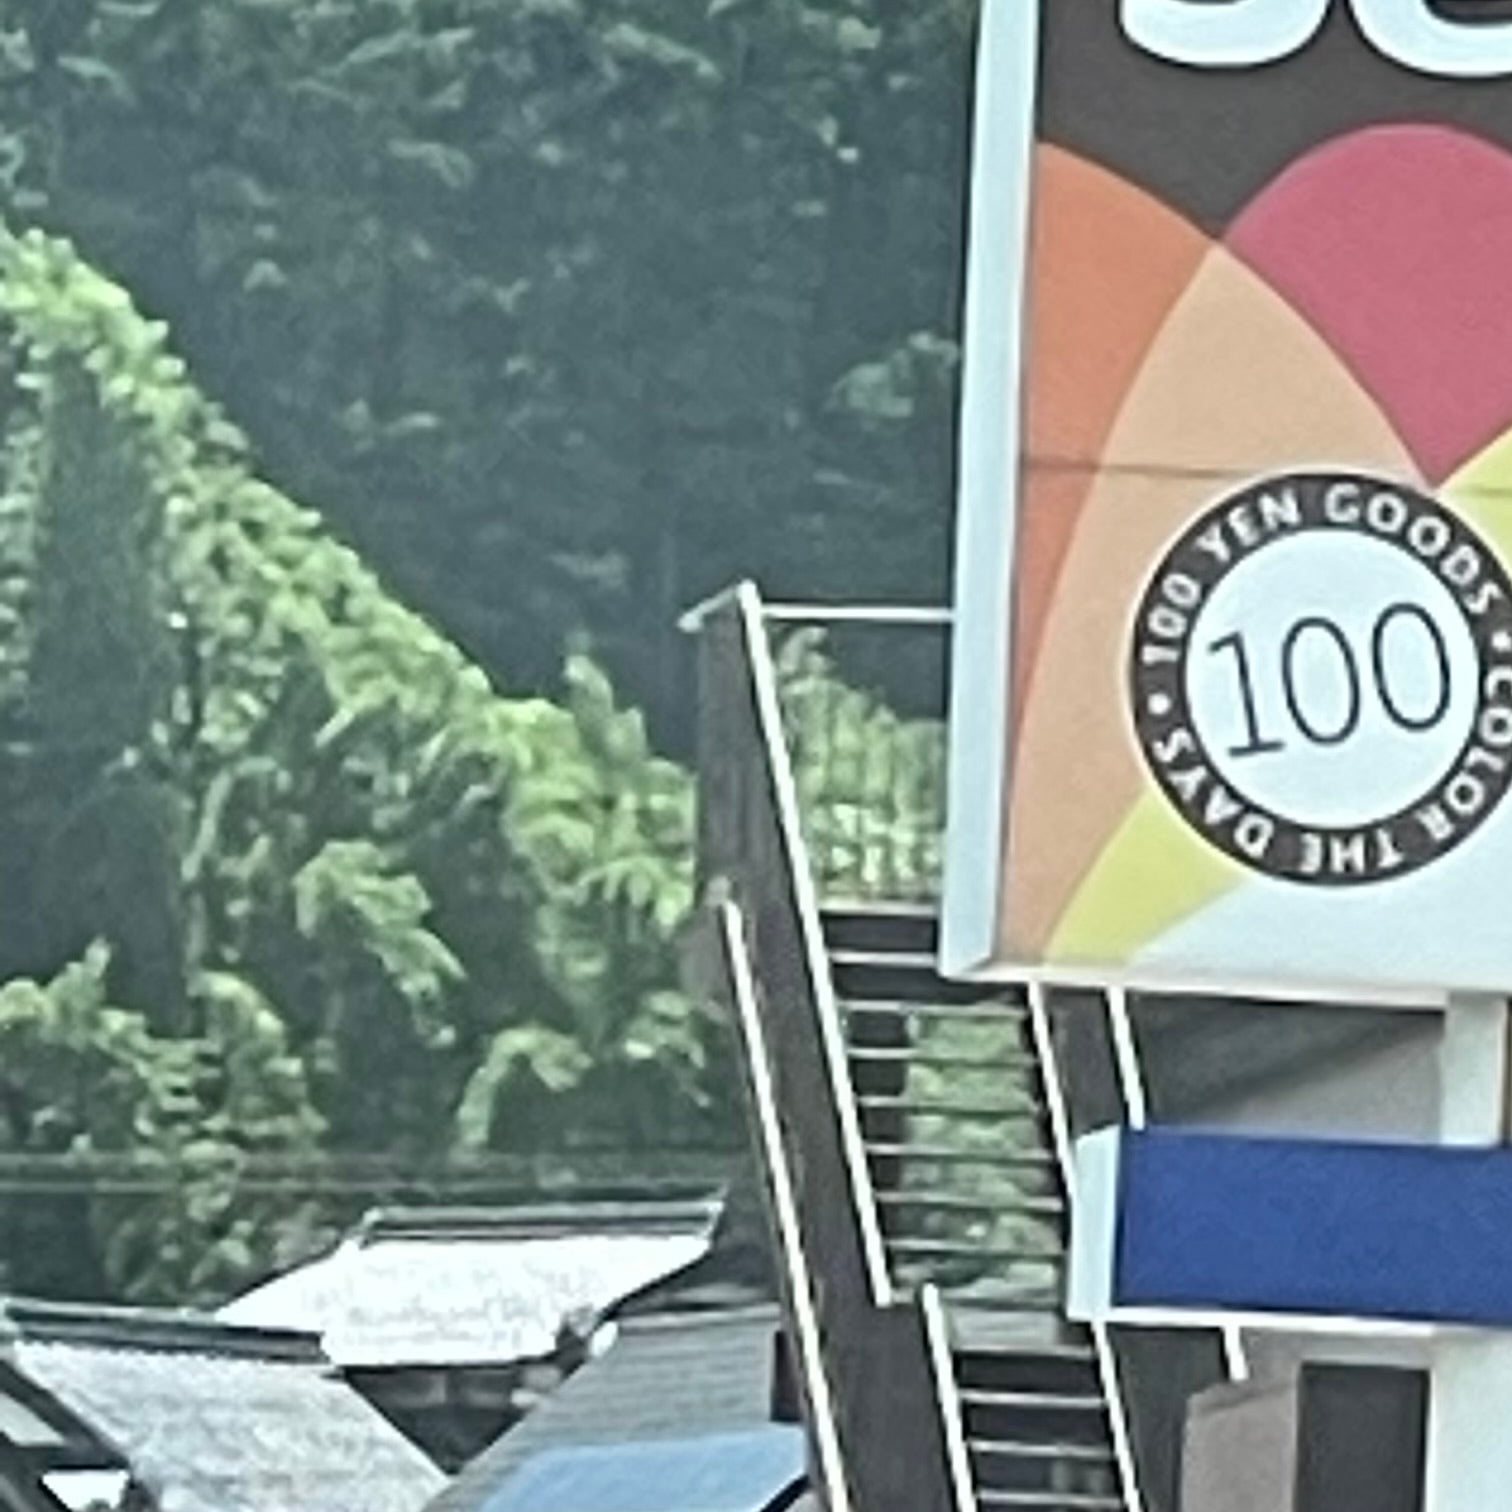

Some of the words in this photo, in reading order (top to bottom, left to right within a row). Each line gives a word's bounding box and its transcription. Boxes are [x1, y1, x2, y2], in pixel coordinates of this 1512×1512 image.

[1142, 574, 1198, 666] 100
[1196, 489, 1301, 562] YEN
[1323, 483, 1503, 615] GOODS
[1207, 602, 1452, 758] 100
[1152, 727, 1275, 859] DAYS
[1300, 827, 1404, 874] THE
